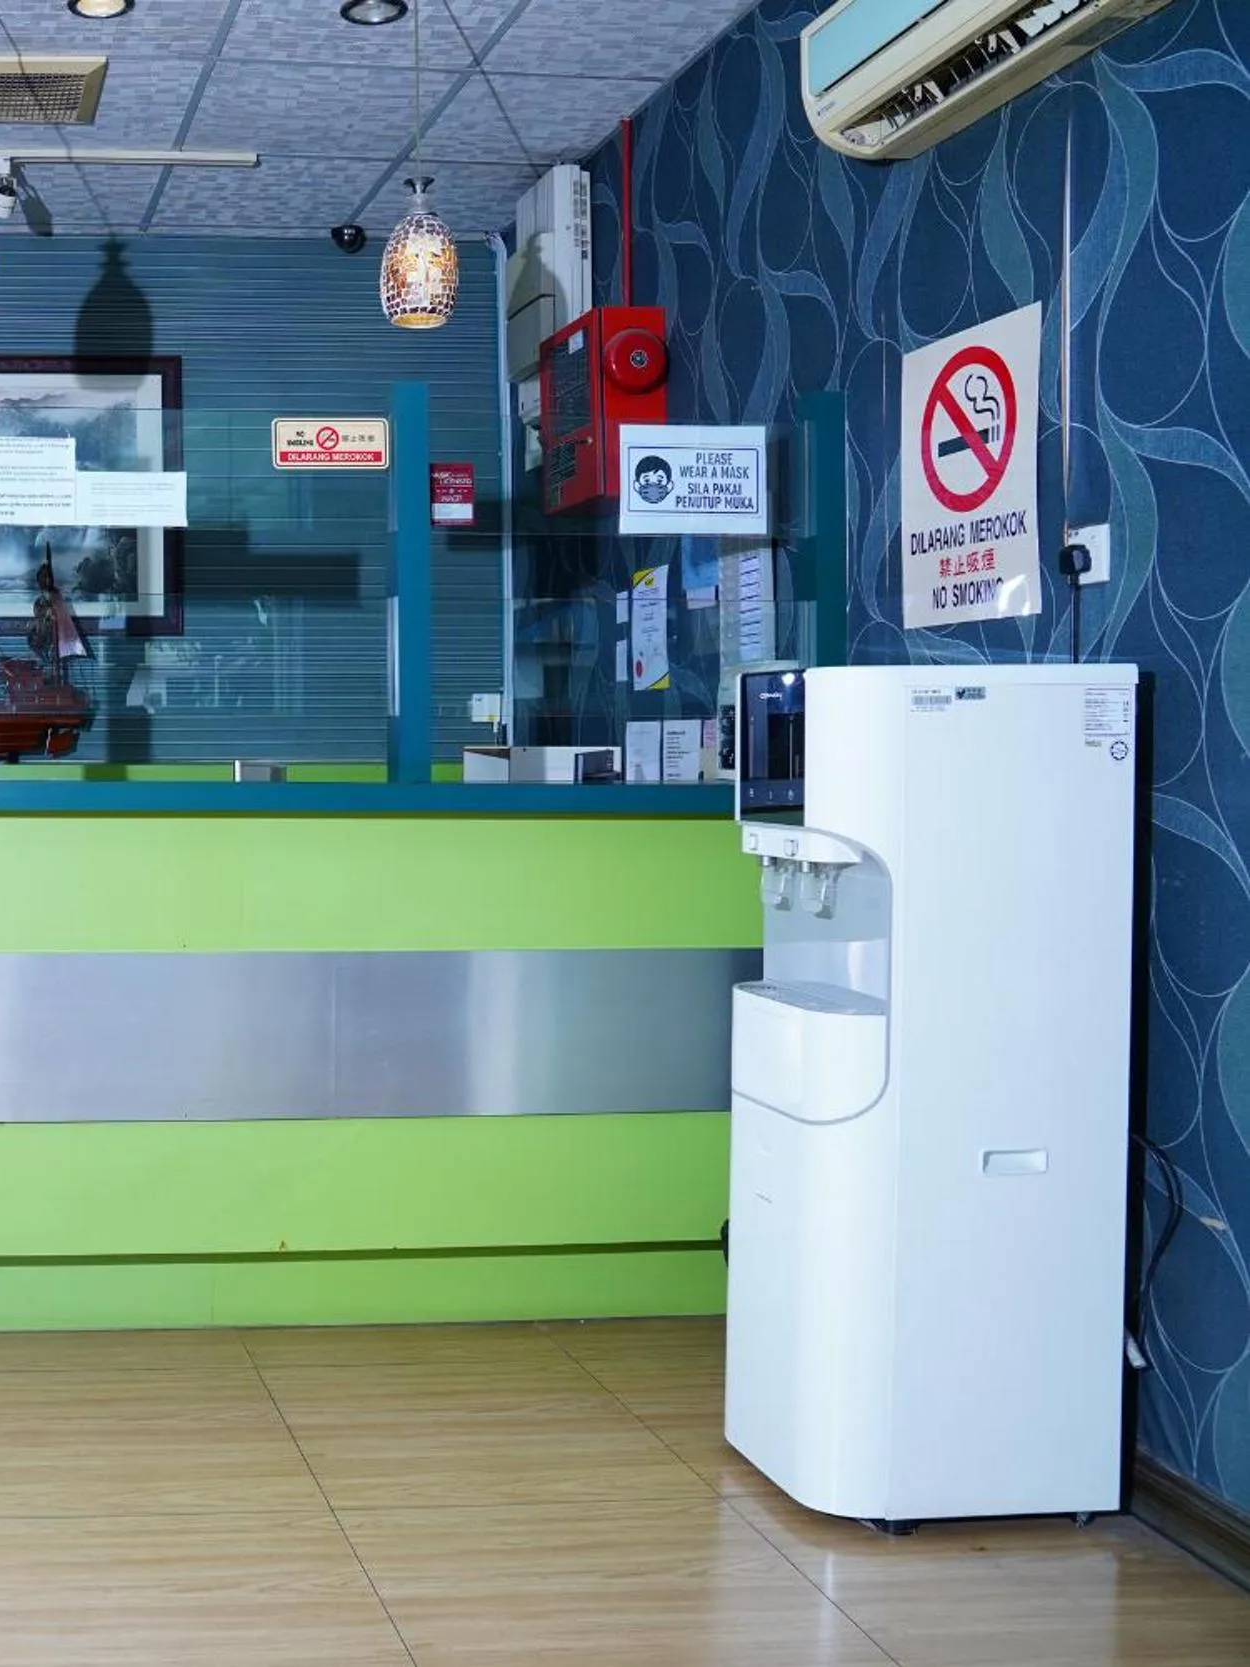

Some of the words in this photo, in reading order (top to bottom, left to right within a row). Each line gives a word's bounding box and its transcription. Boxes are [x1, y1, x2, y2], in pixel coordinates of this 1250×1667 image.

[287, 452, 330, 461] DILARANG
[332, 452, 375, 461] MEROKOK
[695, 452, 733, 465] PLEASE
[680, 466, 708, 479] WEAR
[711, 467, 718, 479] A
[720, 466, 749, 479] MASK
[687, 483, 709, 495] SILA
[713, 483, 743, 495] PAKAI
[675, 496, 721, 509] PENUTUP
[724, 497, 754, 510] MUKA
[911, 524, 966, 555] DILARANG
[969, 510, 1027, 545] MEROKOK
[932, 586, 947, 609] NO
